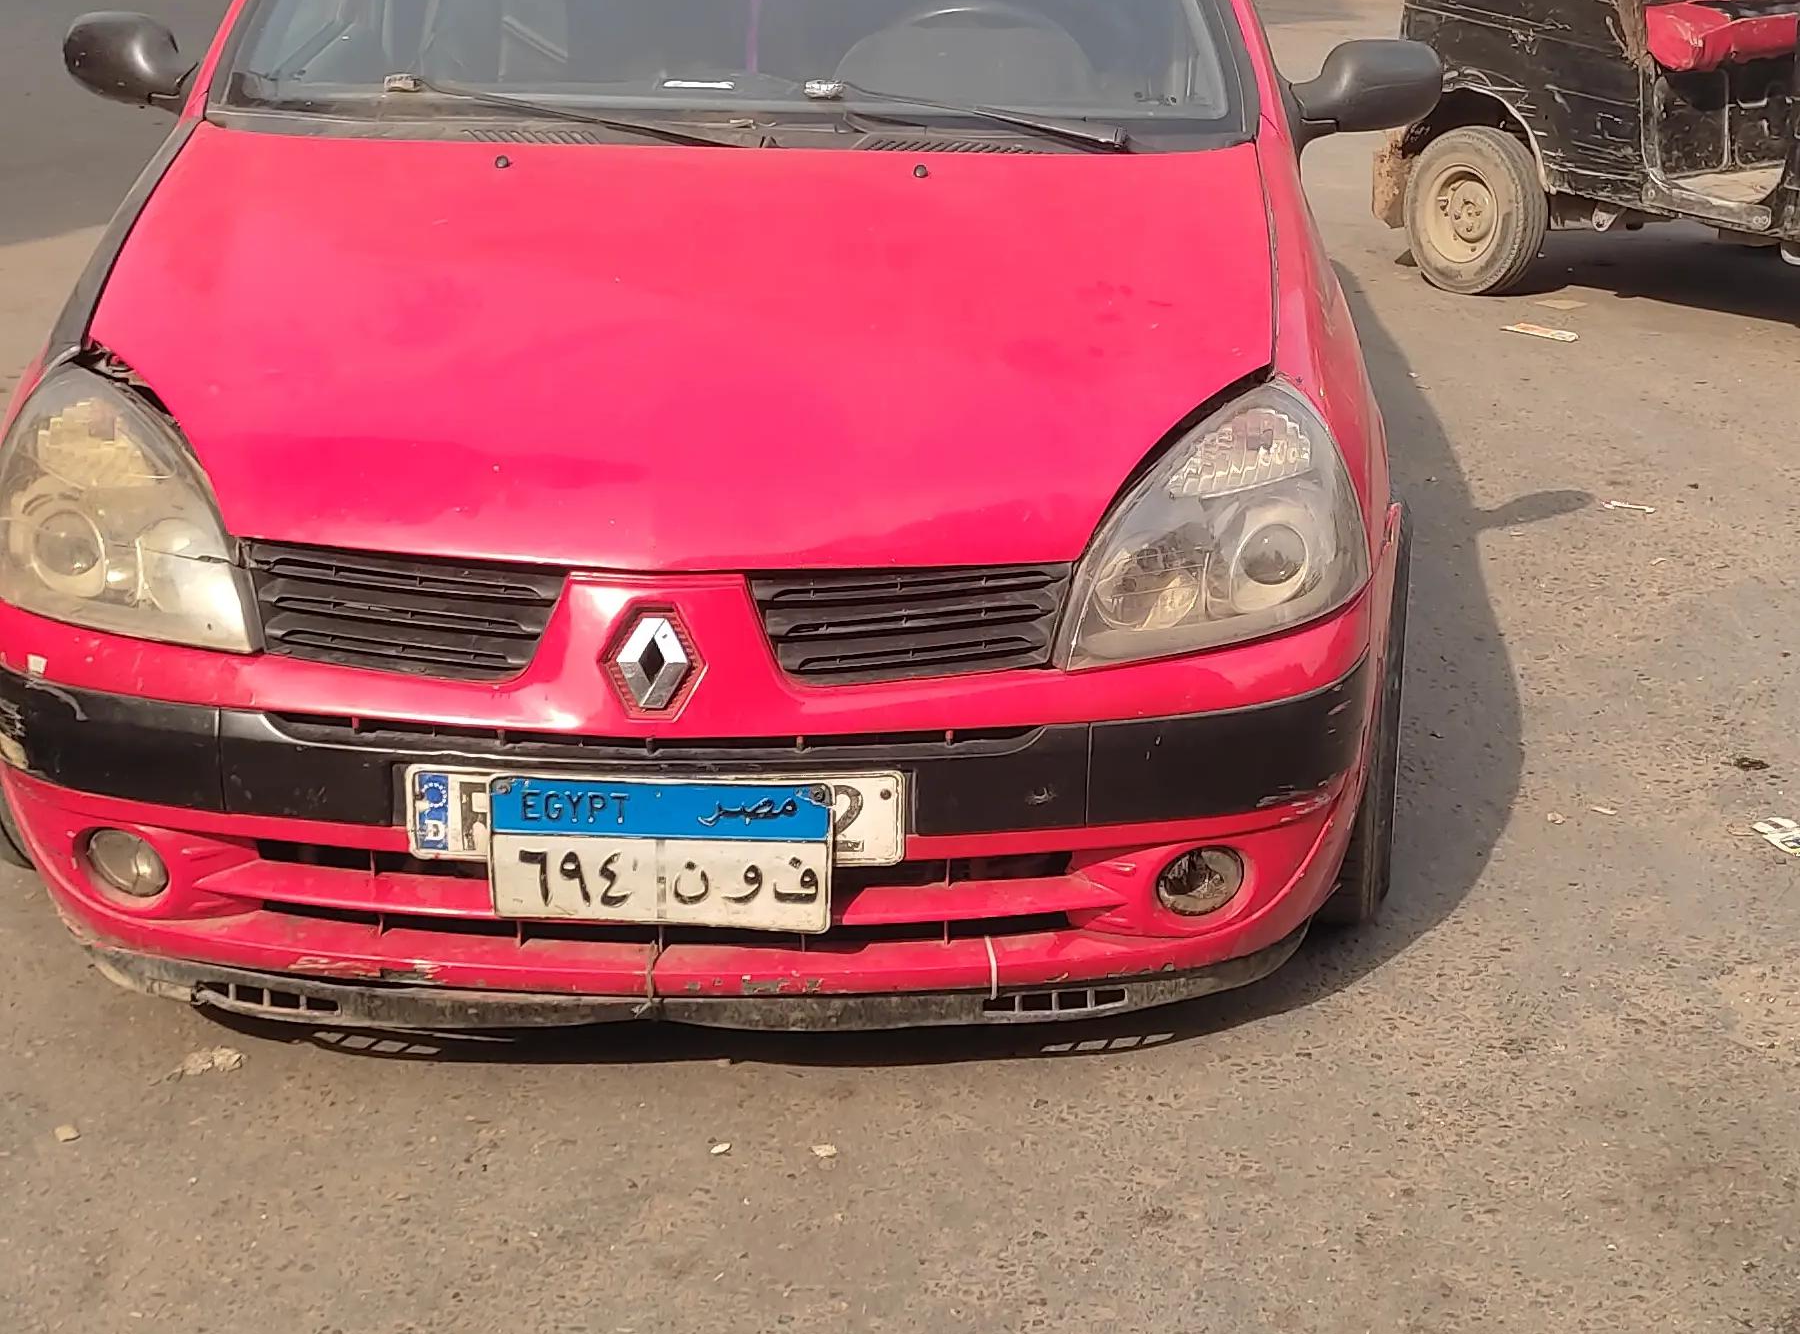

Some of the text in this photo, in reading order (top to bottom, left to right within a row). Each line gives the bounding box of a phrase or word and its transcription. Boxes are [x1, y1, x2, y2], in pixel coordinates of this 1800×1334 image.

[521, 789, 630, 825] EGYPT
[697, 796, 799, 828] مصر
[517, 849, 635, 909] ٦٩٤
